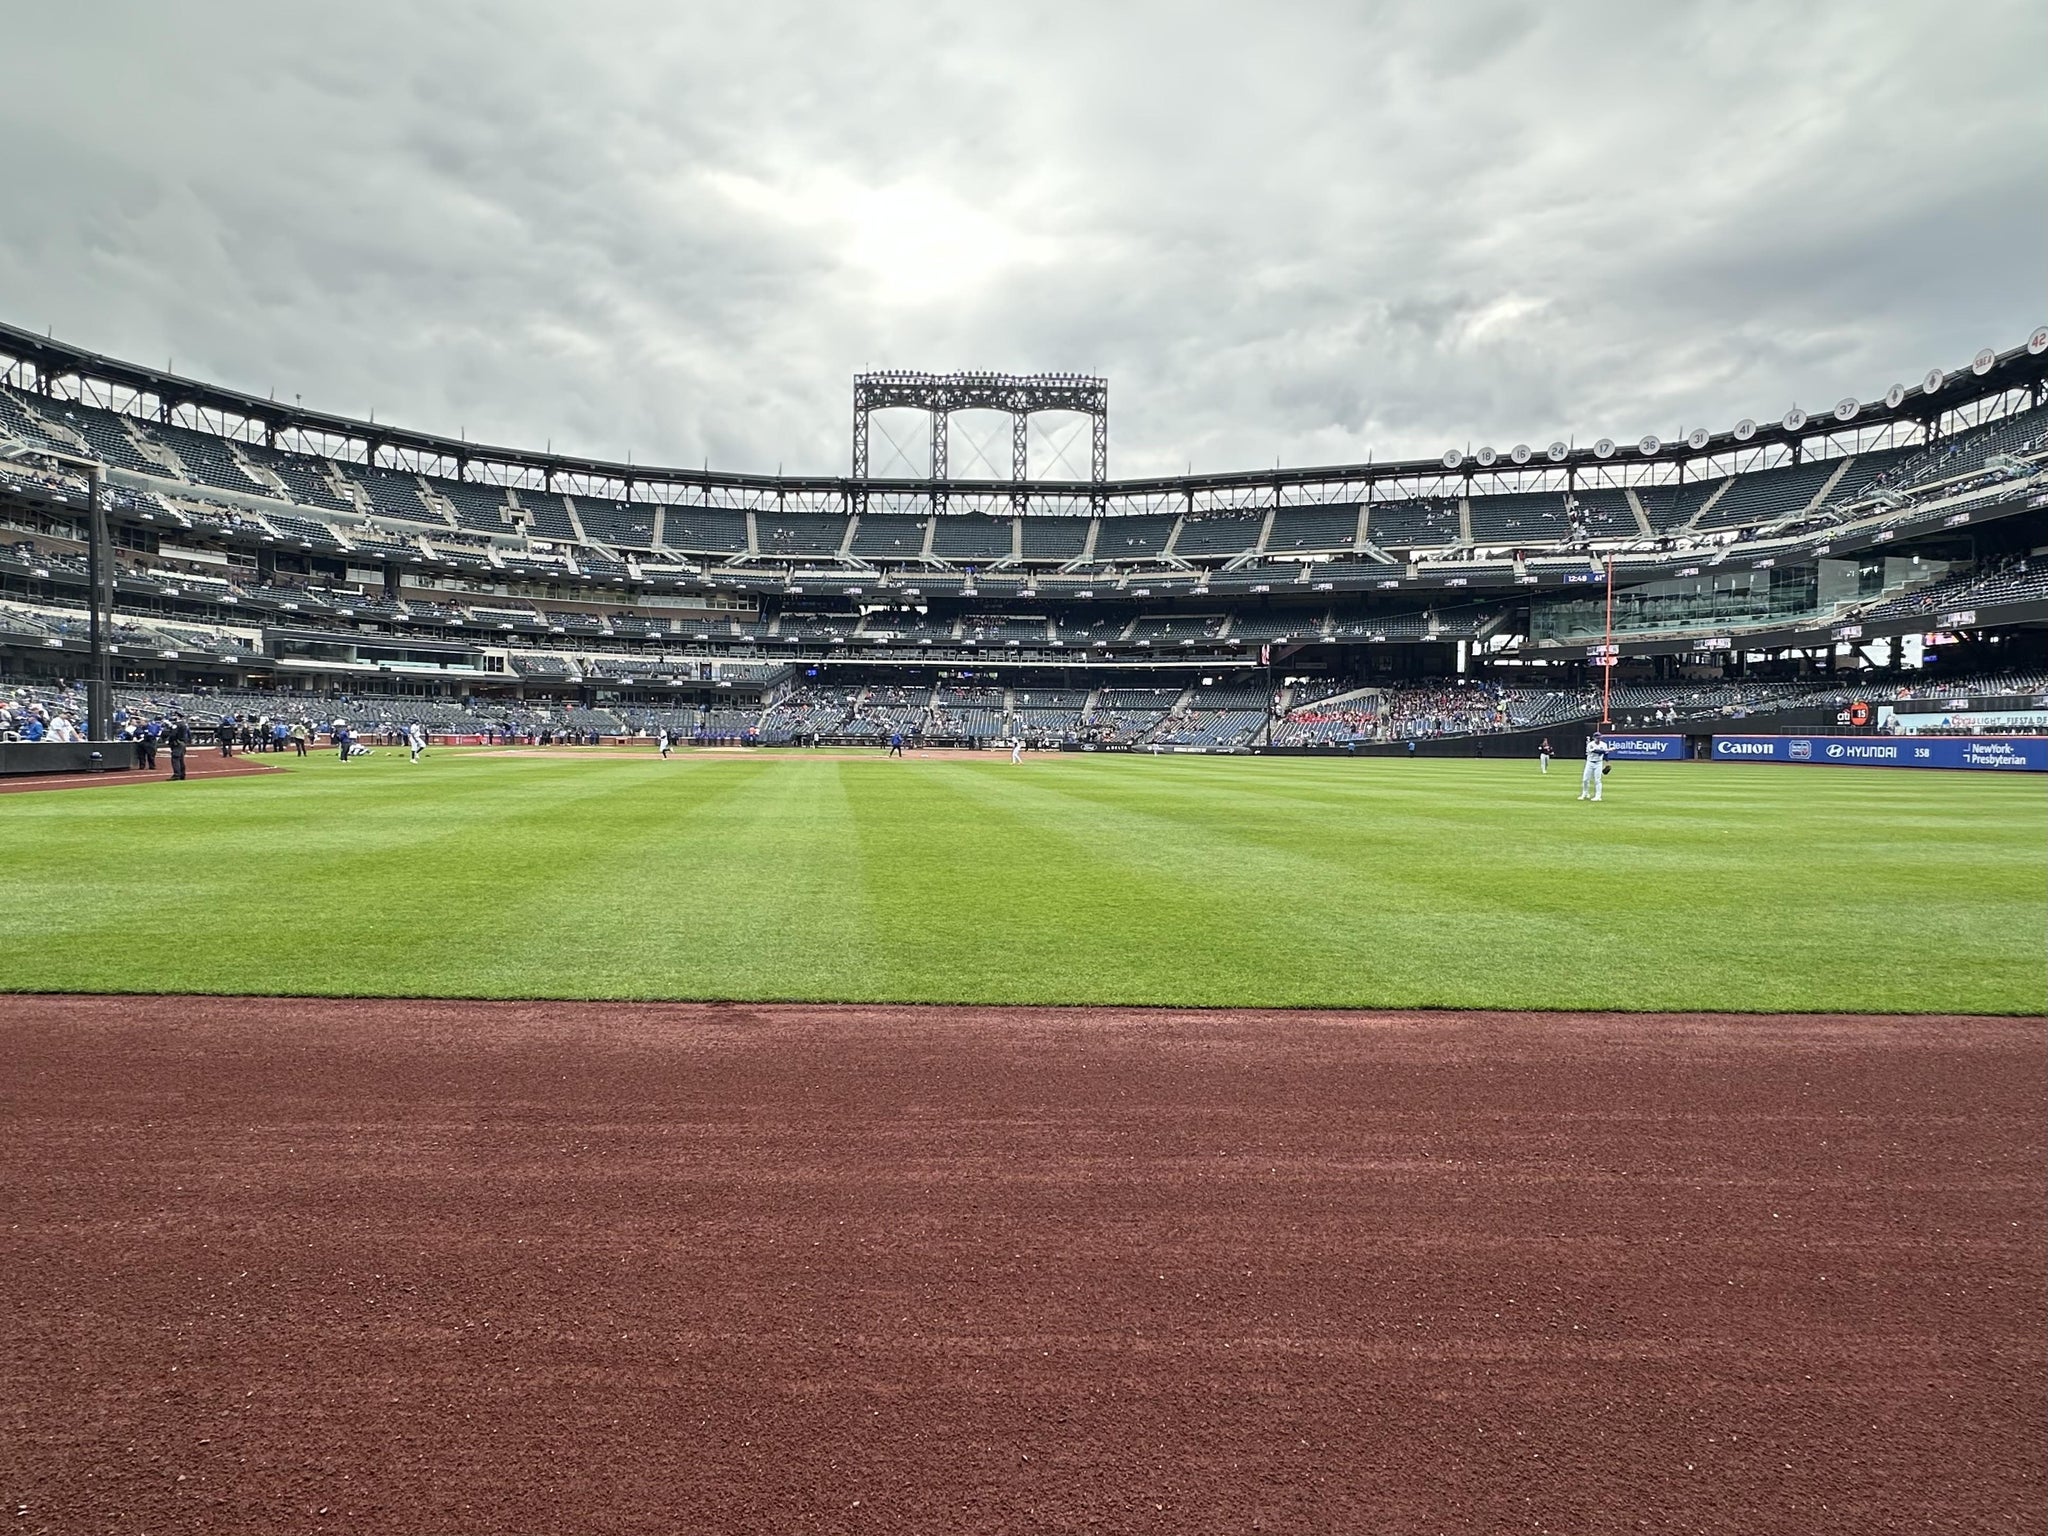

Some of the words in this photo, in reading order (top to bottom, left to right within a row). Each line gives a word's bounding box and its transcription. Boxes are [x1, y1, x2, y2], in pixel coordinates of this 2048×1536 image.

[2031, 332, 2047, 348] 42
[1974, 355, 1992, 369] SHEA
[1839, 403, 1854, 416] 37
[1788, 414, 1800, 426] 14
[1739, 424, 1750, 435] 41
[1694, 434, 1704, 444] 31
[1600, 443, 1610, 453] 17
[1643, 440, 1656, 450] 36
[1482, 452, 1491, 462] 18
[1516, 449, 1526, 459] 16
[1551, 446, 1564, 457] 24
[1449, 454, 1456, 463] 5
[1977, 716, 2001, 725] LIGHT
[1608, 740, 1669, 753] HealthEquity
[1717, 741, 1774, 755] Canon
[1846, 746, 1897, 758] HYUNDAI
[1972, 743, 2014, 754] NewYork-
[1914, 747, 1930, 758] 358
[1971, 754, 2026, 767] Presbyterian
